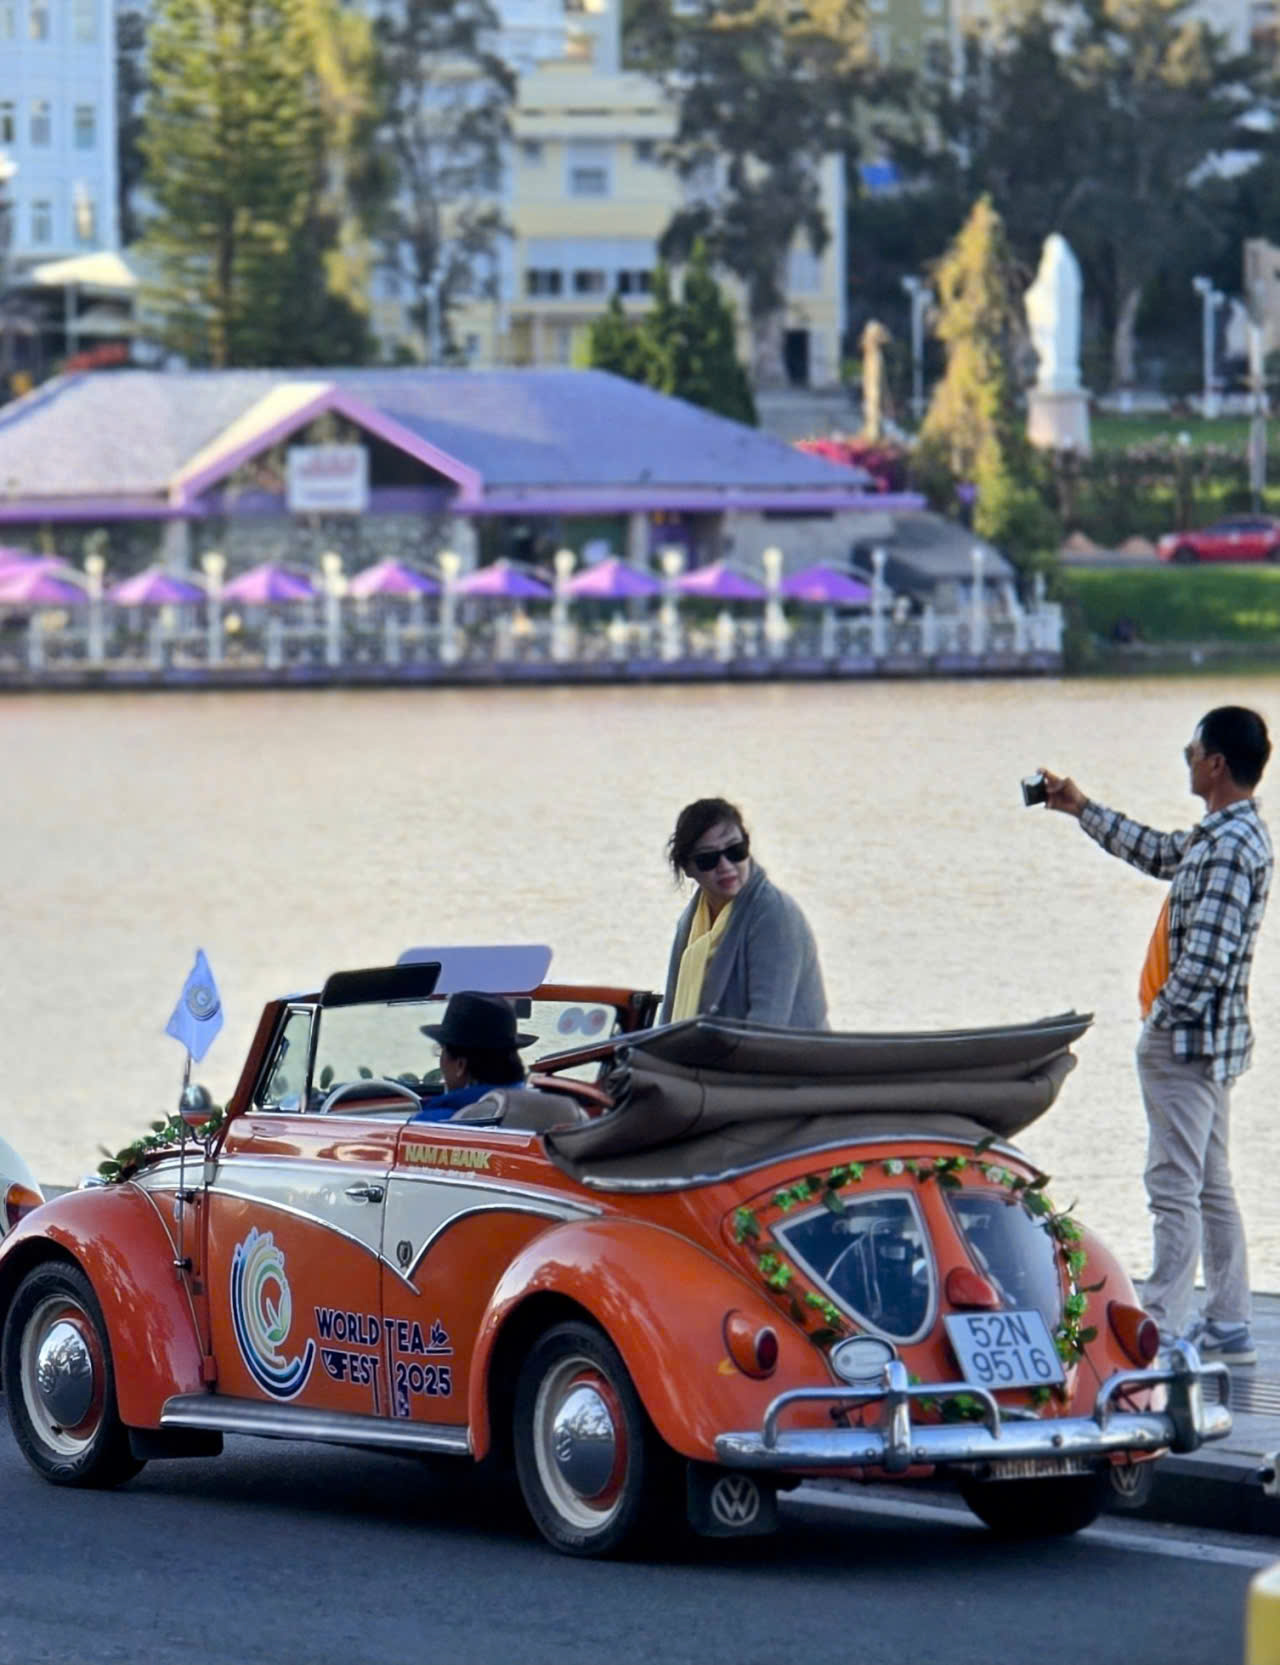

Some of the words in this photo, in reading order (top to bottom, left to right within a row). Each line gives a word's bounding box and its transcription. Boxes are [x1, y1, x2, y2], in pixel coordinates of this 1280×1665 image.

[404, 1144, 438, 1164] NAM
[450, 1149, 491, 1169] BANK
[315, 1307, 380, 1346] WORLD
[967, 1314, 1031, 1349] 52N
[396, 1361, 451, 1396] 2025
[972, 1348, 1052, 1382] 9516
